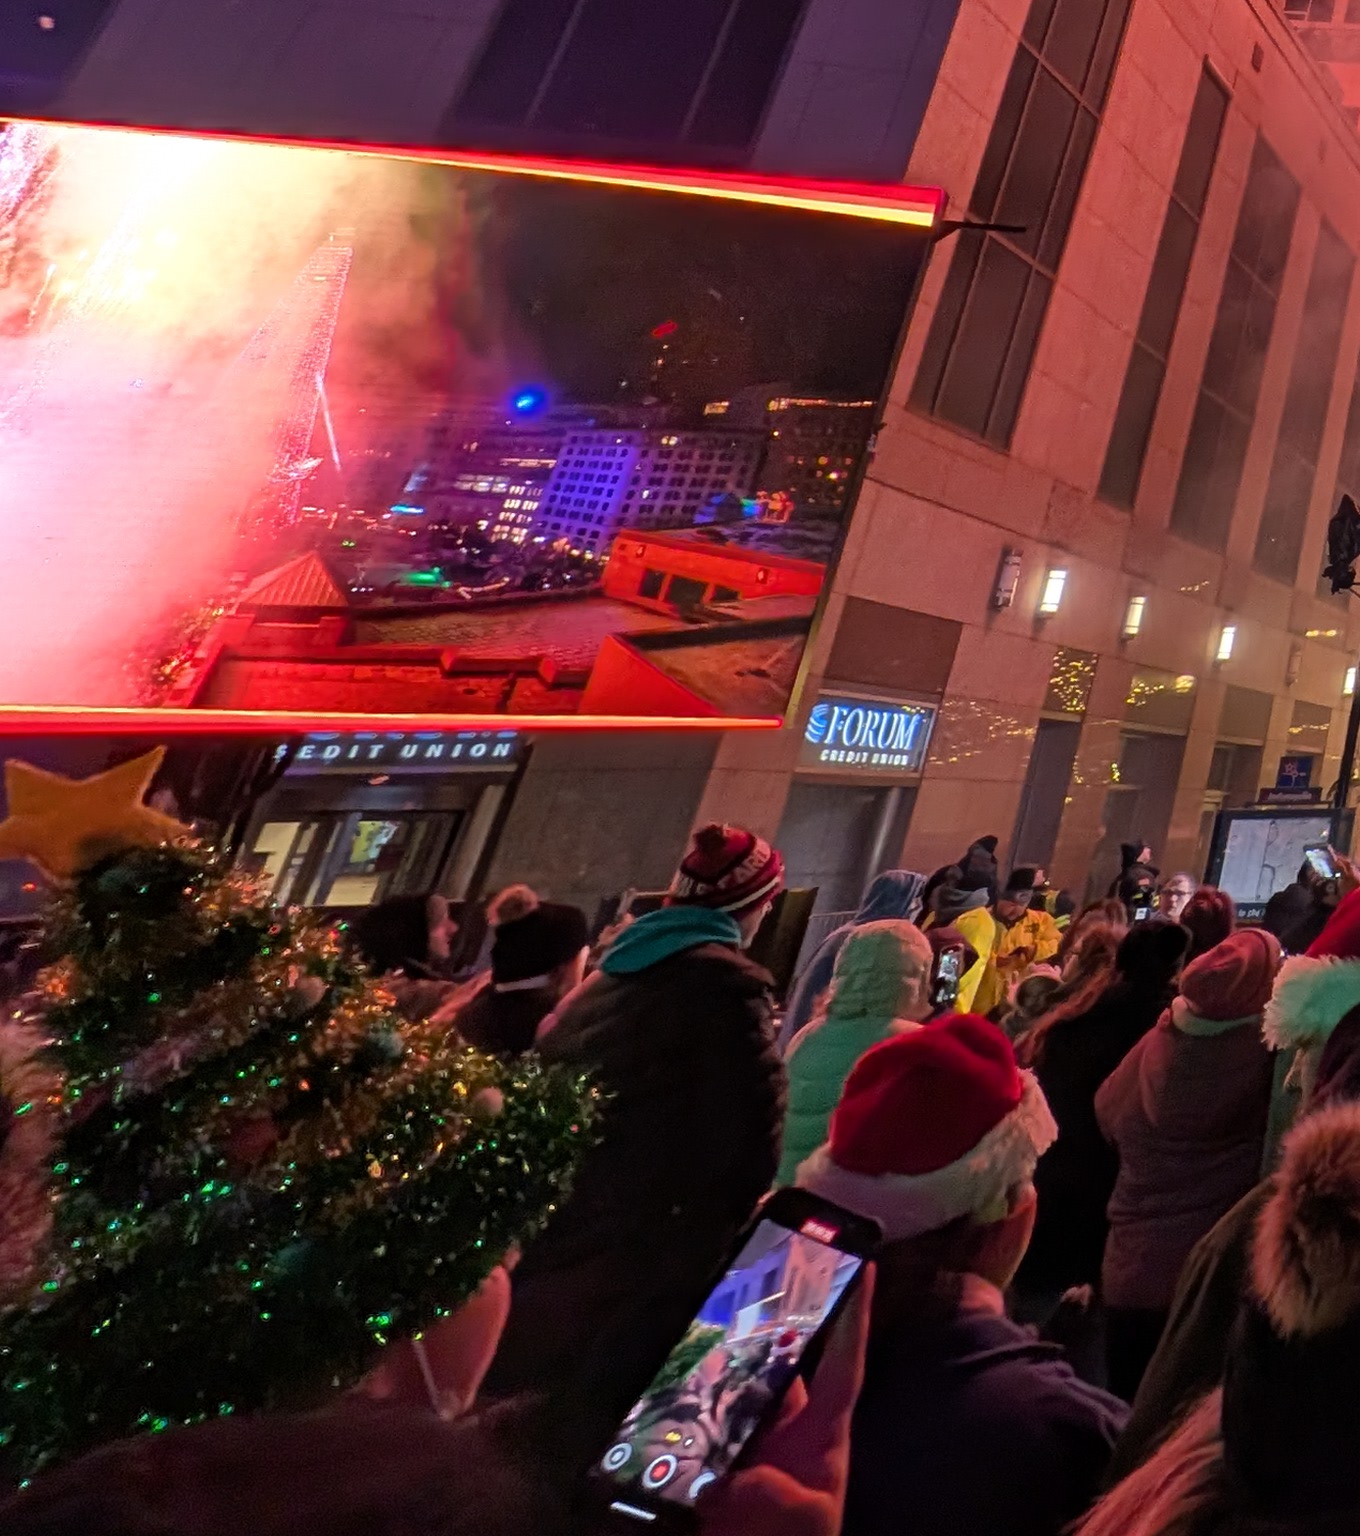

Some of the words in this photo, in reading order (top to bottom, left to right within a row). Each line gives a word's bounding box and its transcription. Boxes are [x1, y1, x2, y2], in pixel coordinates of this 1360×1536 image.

[824, 705, 923, 751] FORUM
[401, 742, 511, 758] UNION
[819, 748, 868, 763] CREDIT
[871, 751, 909, 766] UNION
